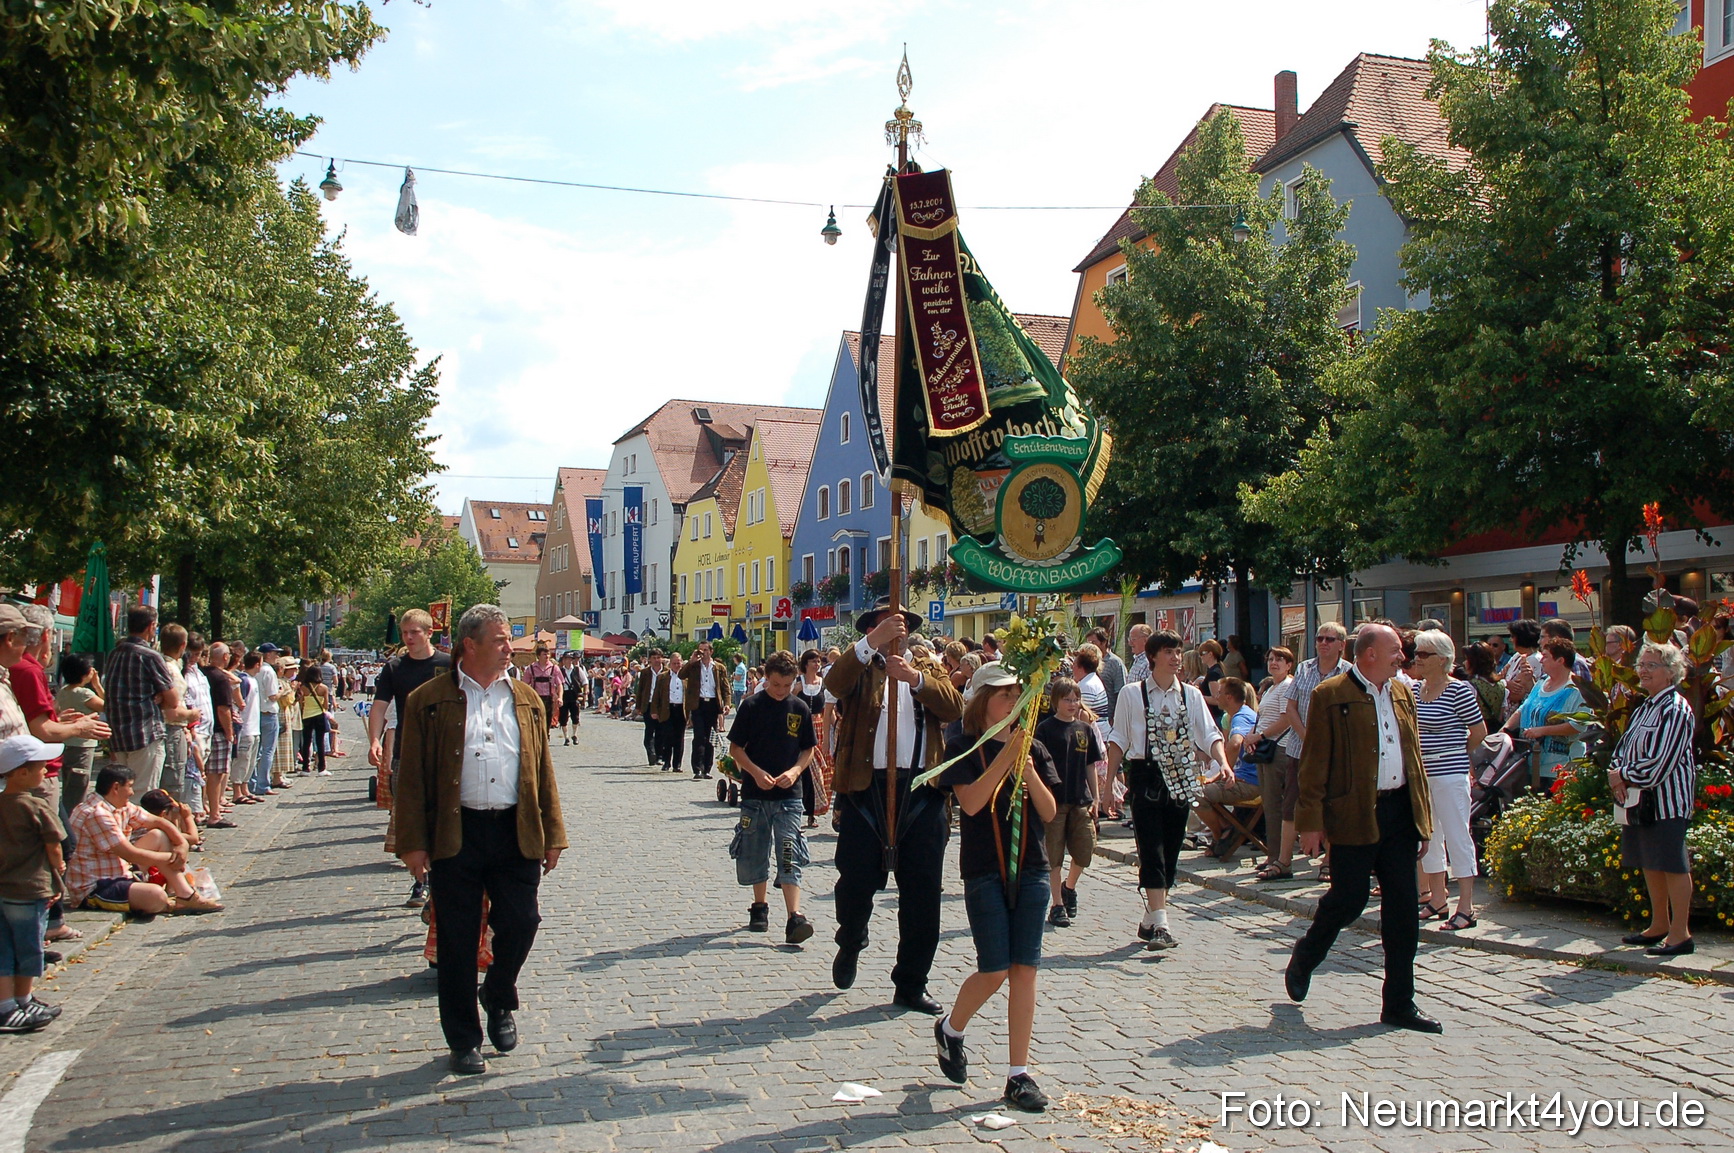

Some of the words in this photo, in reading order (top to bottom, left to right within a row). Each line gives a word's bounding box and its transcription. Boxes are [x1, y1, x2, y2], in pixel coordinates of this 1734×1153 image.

[921, 249, 941, 261] Zur
[909, 266, 956, 281] Fahnen-
[921, 280, 951, 294] weihe
[939, 306, 951, 314] der
[1013, 440, 1083, 455] Schützenverein
[632, 526, 640, 563] RUPPERT
[698, 553, 711, 567] HOTEL
[987, 560, 1090, 586] WOFFENBACH
[931, 603, 942, 620] P
